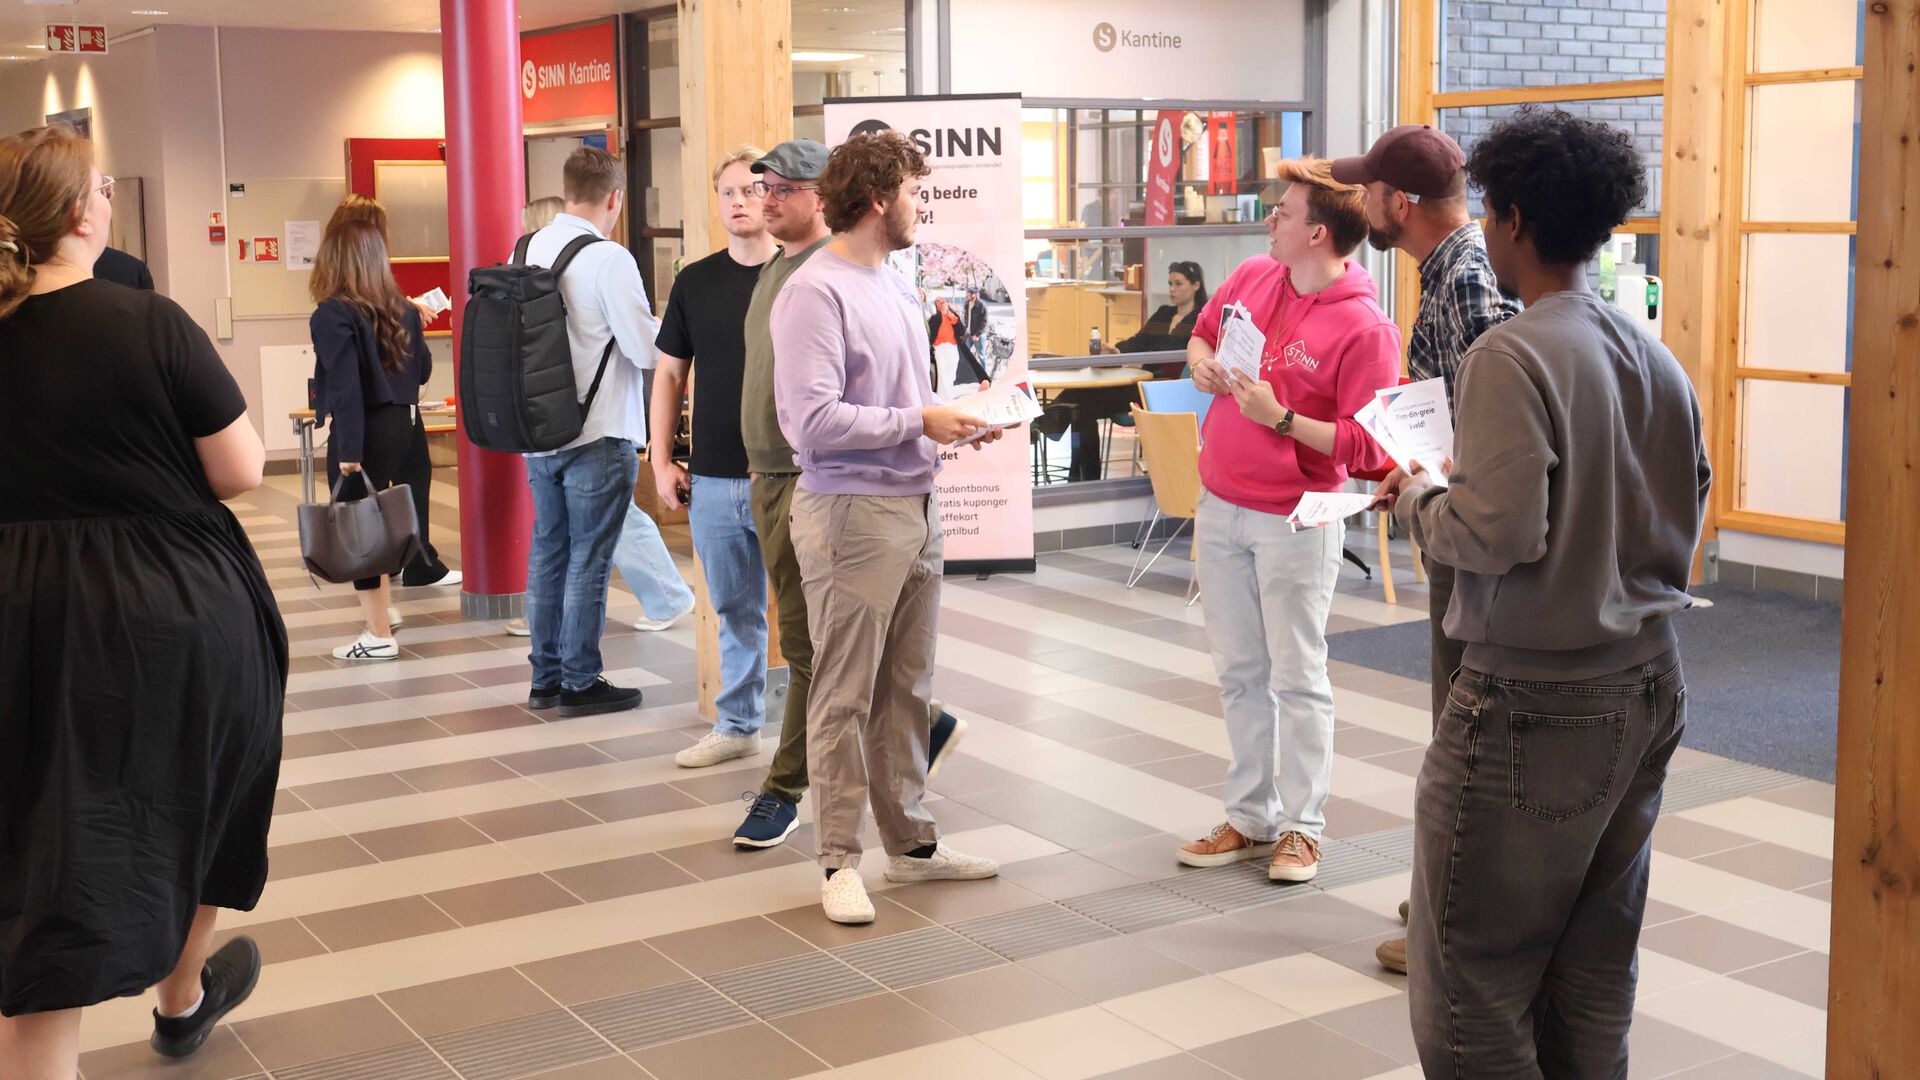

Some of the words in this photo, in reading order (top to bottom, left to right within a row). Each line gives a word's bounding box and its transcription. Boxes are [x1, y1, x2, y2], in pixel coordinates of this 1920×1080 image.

[1121, 30, 1181, 48] Kantine
[538, 63, 565, 89] SINN
[569, 59, 611, 85] Kantine
[909, 127, 1001, 157] SINN
[933, 186, 977, 199] bedre
[939, 451, 959, 460] det
[937, 499, 961, 507] ratis
[963, 498, 1008, 508] kuponger
[940, 512, 979, 522] affekort
